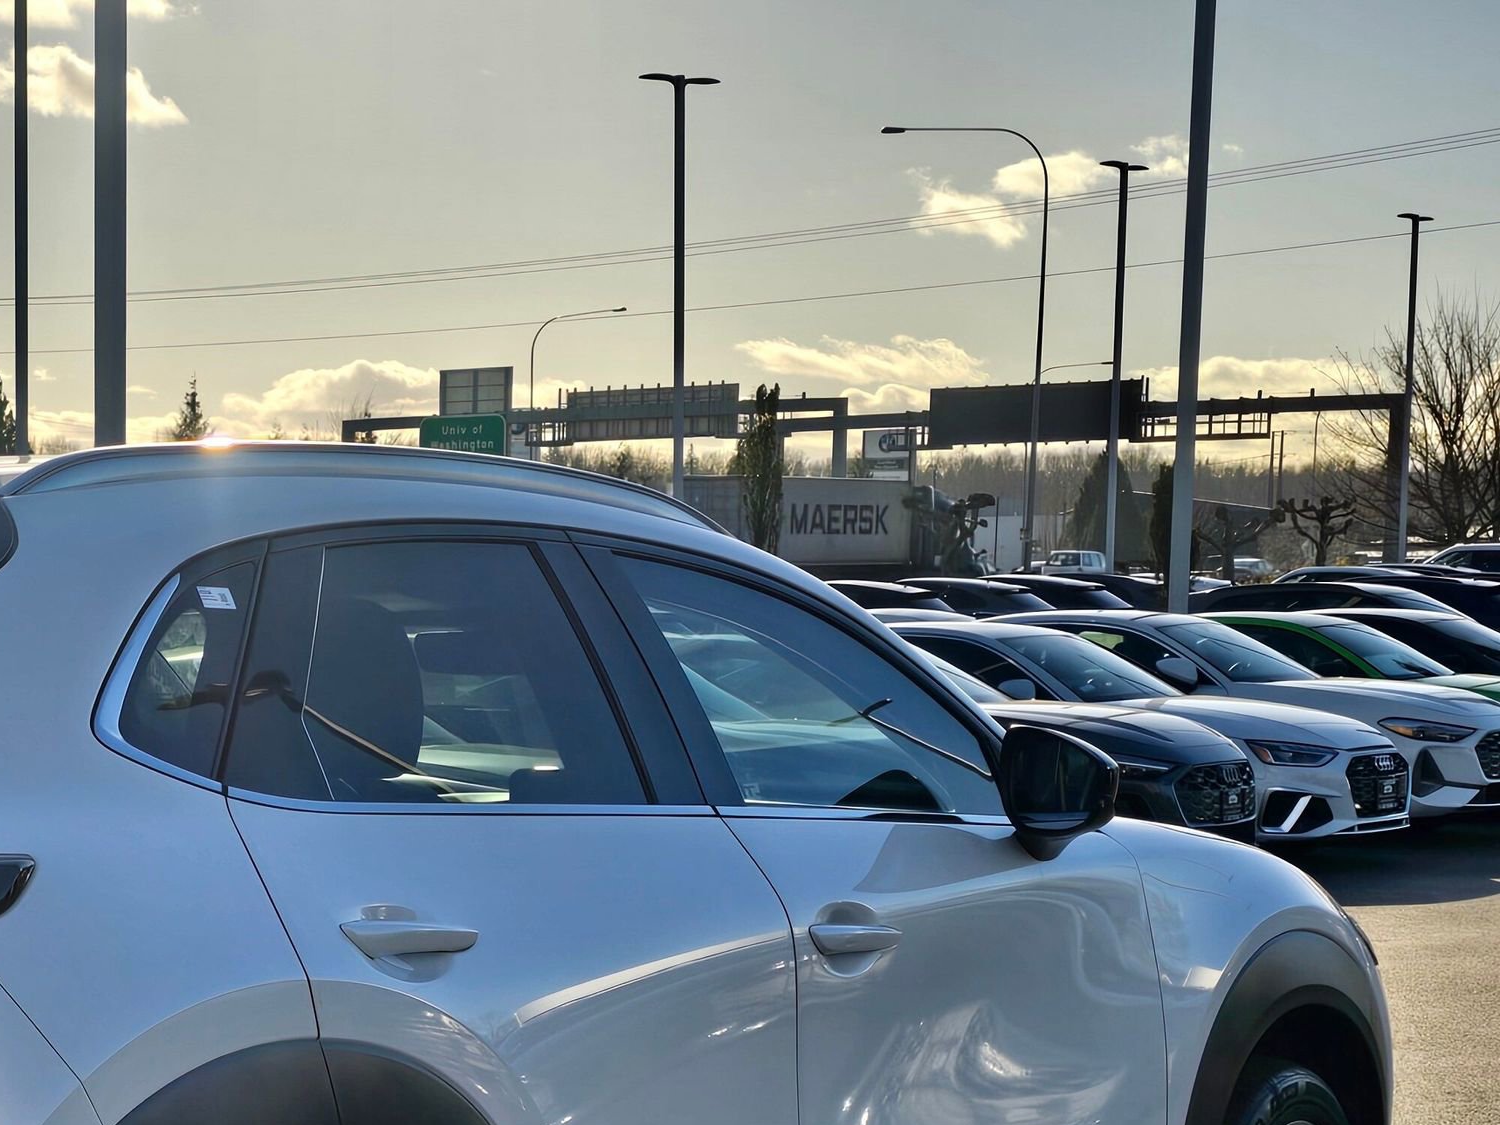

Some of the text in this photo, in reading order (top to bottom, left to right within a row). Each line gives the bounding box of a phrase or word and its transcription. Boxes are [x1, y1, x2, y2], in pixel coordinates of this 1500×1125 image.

[442, 424, 483, 435] Univ of
[790, 503, 889, 535] MAERSK
